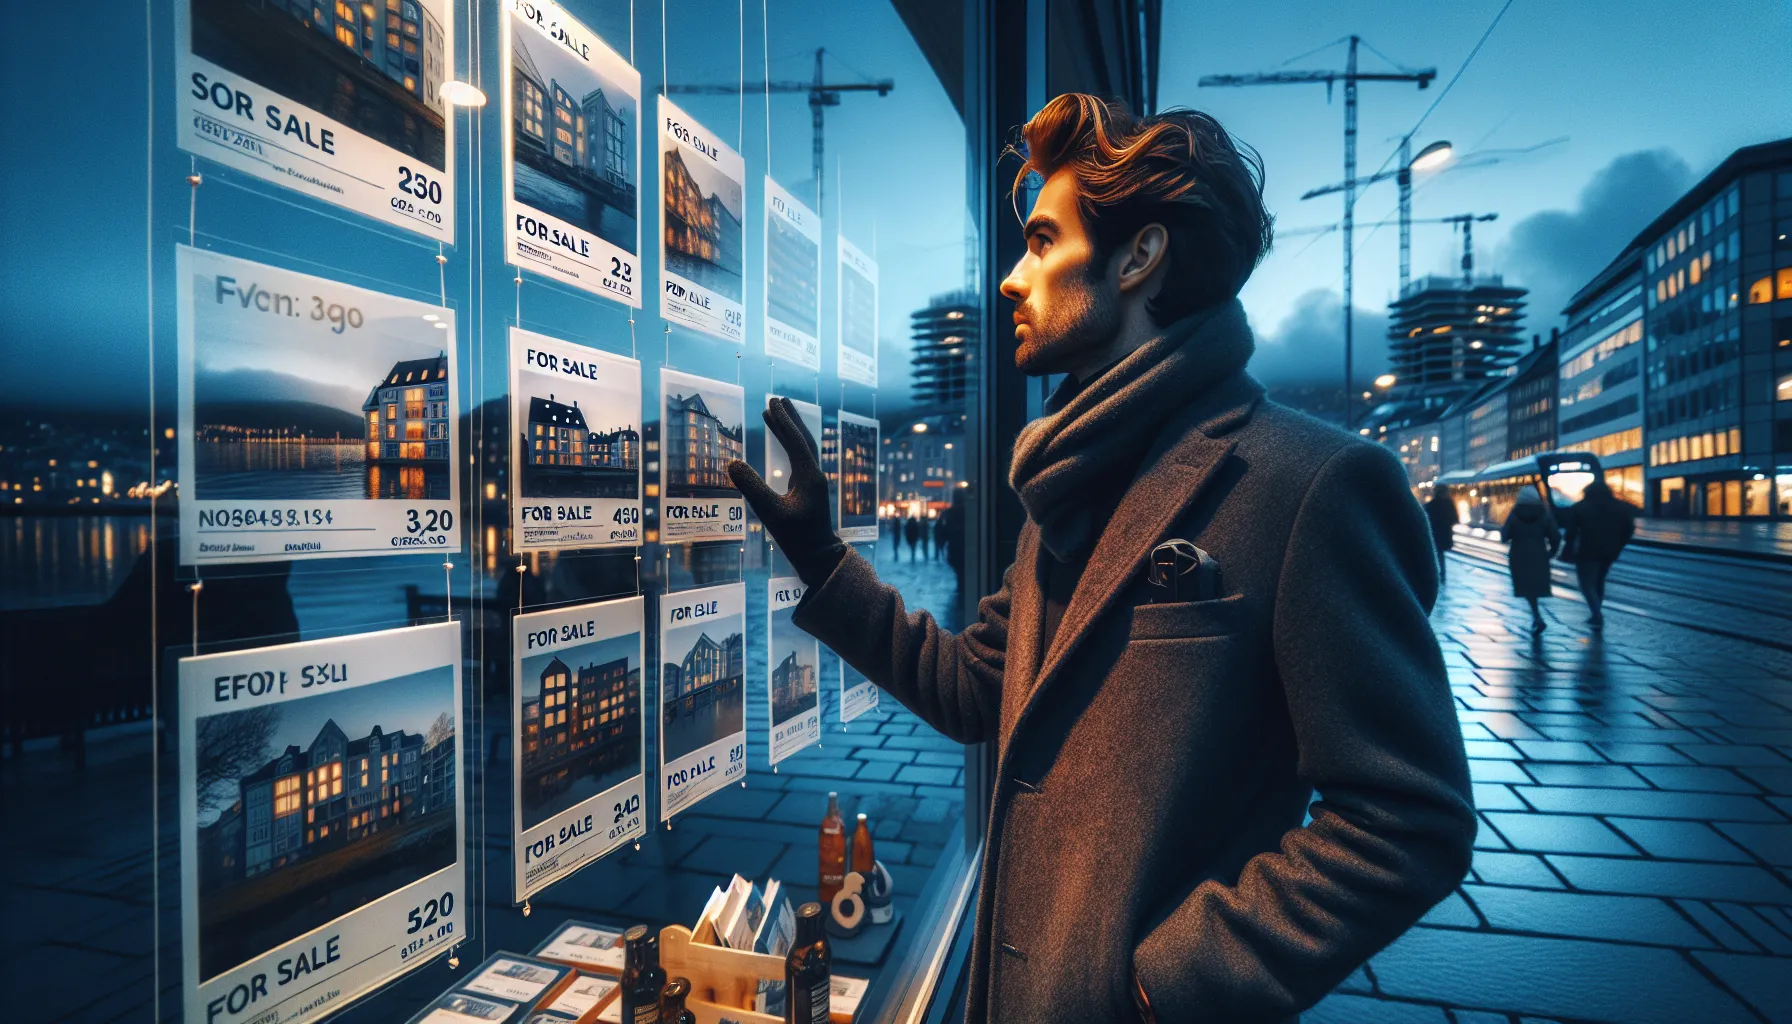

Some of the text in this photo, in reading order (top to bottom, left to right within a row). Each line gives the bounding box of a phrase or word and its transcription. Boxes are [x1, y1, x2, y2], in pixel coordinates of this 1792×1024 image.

[191, 72, 254, 121] SOR
[265, 105, 335, 155] SALE
[398, 166, 442, 204] 230
[527, 349, 598, 380] FOR SALE
[406, 891, 454, 935] 520
[206, 973, 268, 1024] FOR
[277, 934, 341, 986] SALE
